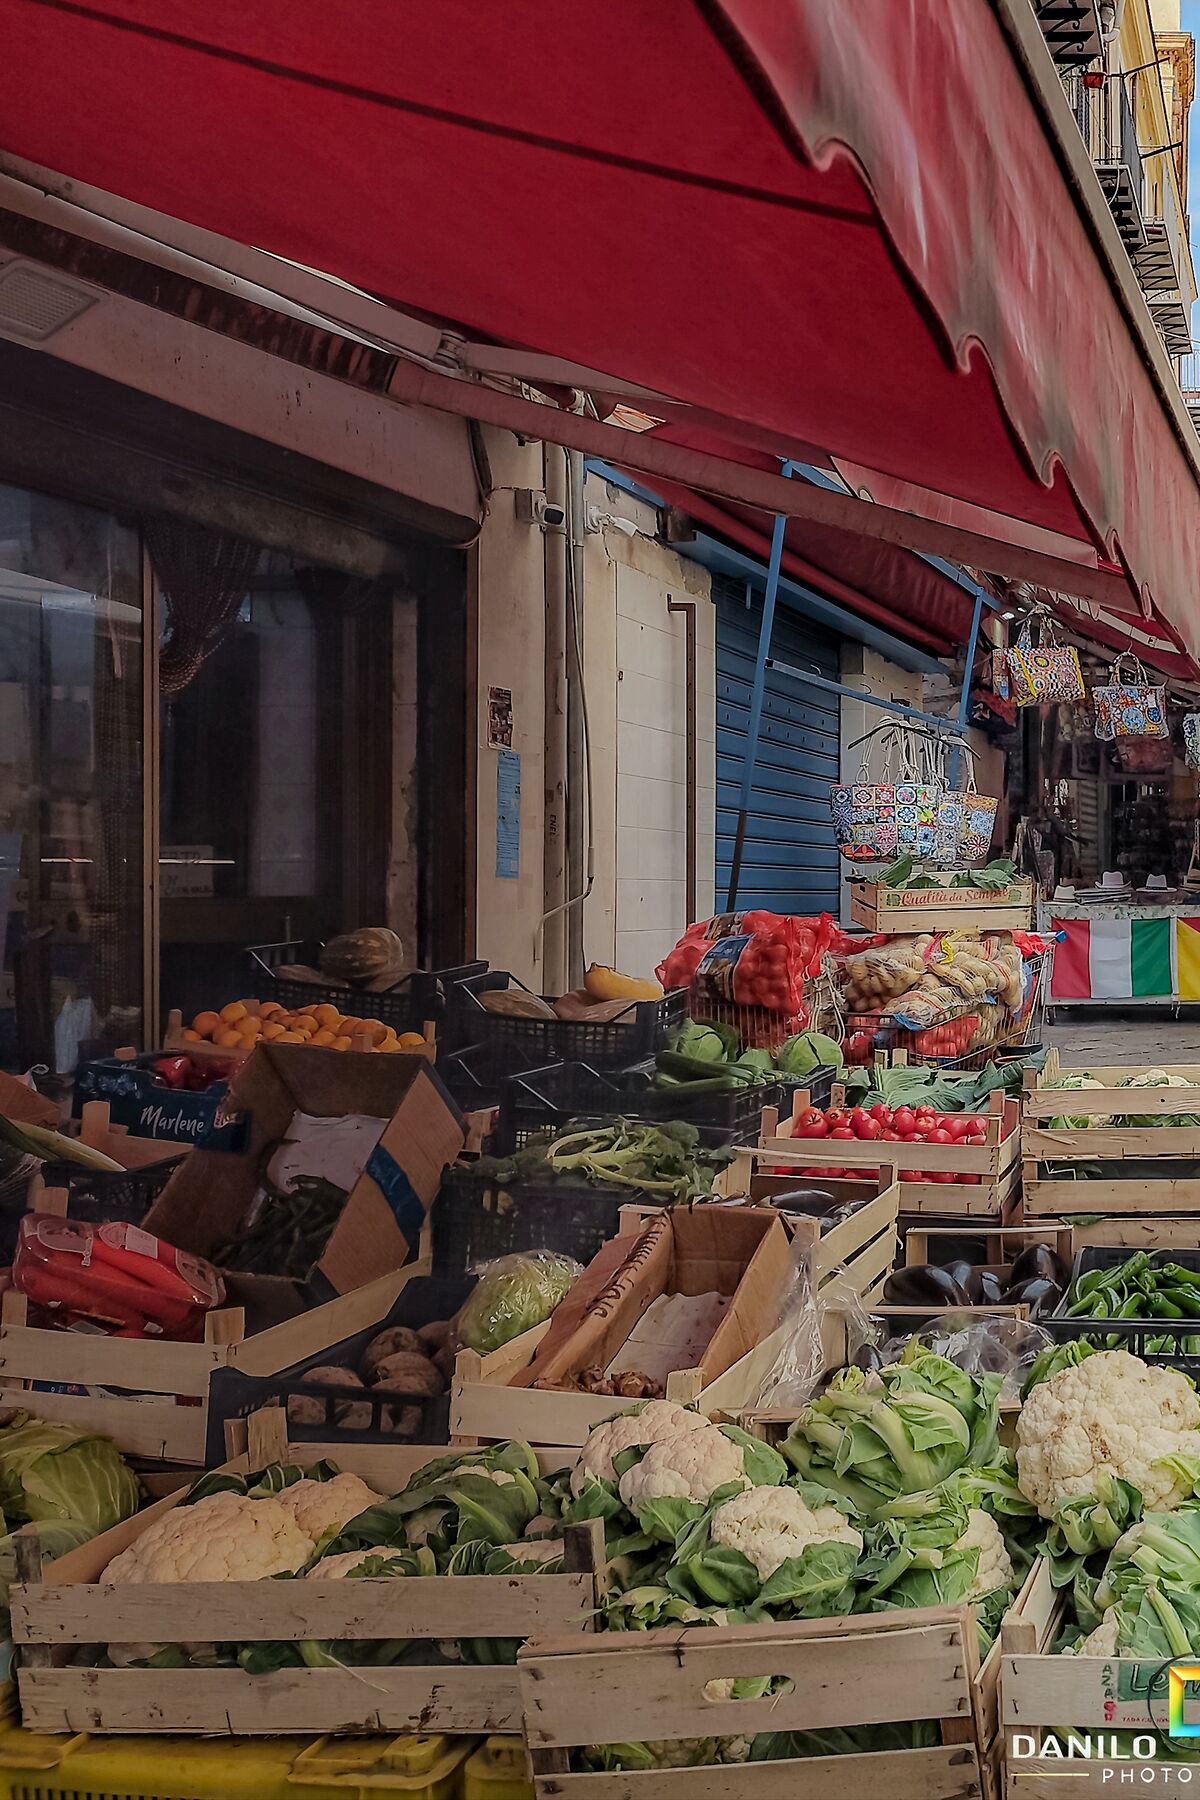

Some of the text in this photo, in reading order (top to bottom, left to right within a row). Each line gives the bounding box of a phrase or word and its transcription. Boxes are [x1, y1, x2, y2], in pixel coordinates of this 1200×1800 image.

[949, 893, 962, 902] da
[965, 888, 1009, 902] Sempre
[140, 1105, 204, 1137] Marlene
